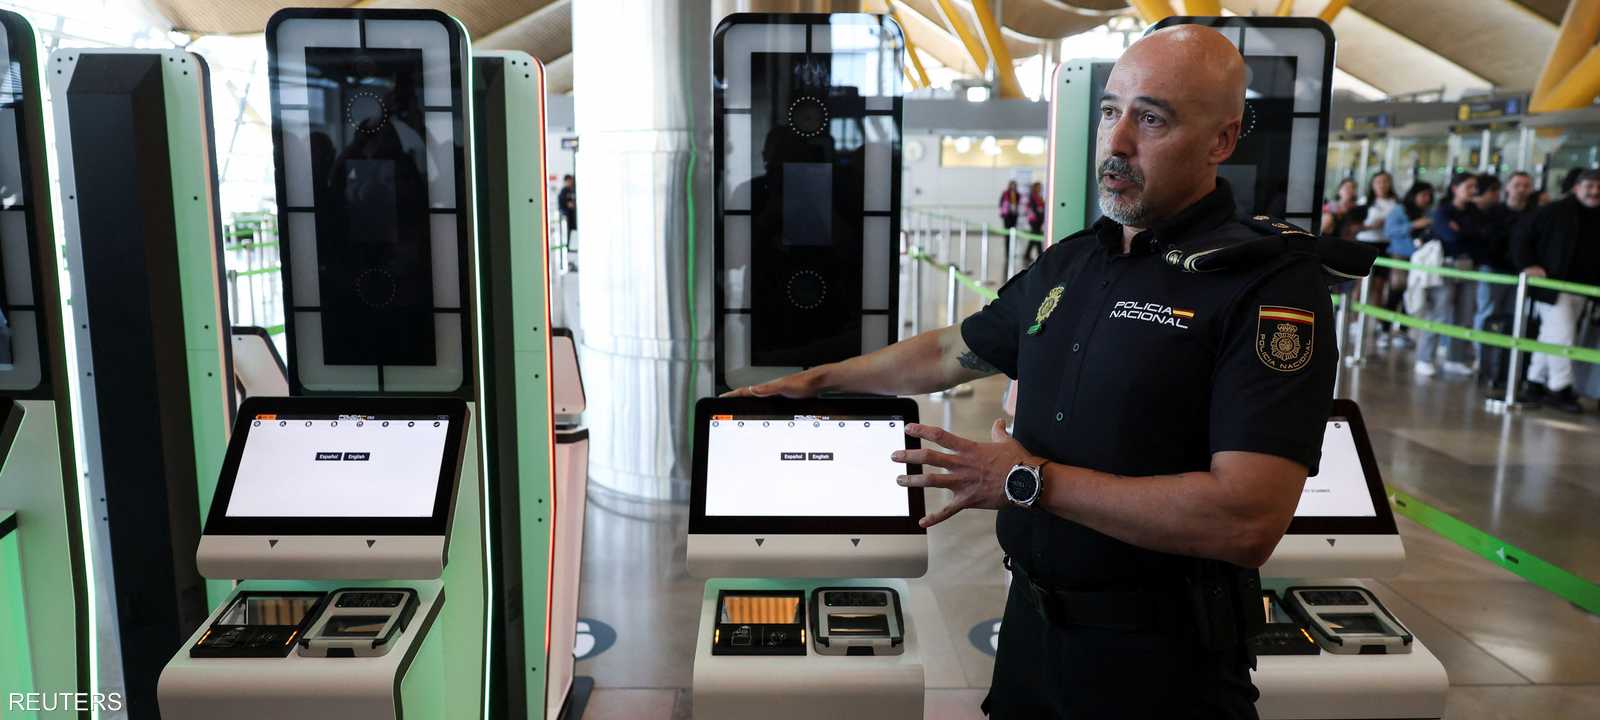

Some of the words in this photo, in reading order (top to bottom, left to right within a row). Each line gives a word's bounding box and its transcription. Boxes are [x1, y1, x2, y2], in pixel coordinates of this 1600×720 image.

[1114, 301, 1172, 315] POLICIA
[1109, 310, 1188, 329] NACIONAL
[1259, 333, 1275, 366] POLICIA
[1280, 339, 1311, 369] NACIONAL
[319, 453, 339, 461] Español
[348, 453, 366, 461] English
[784, 453, 803, 461] Español
[812, 453, 830, 461] English
